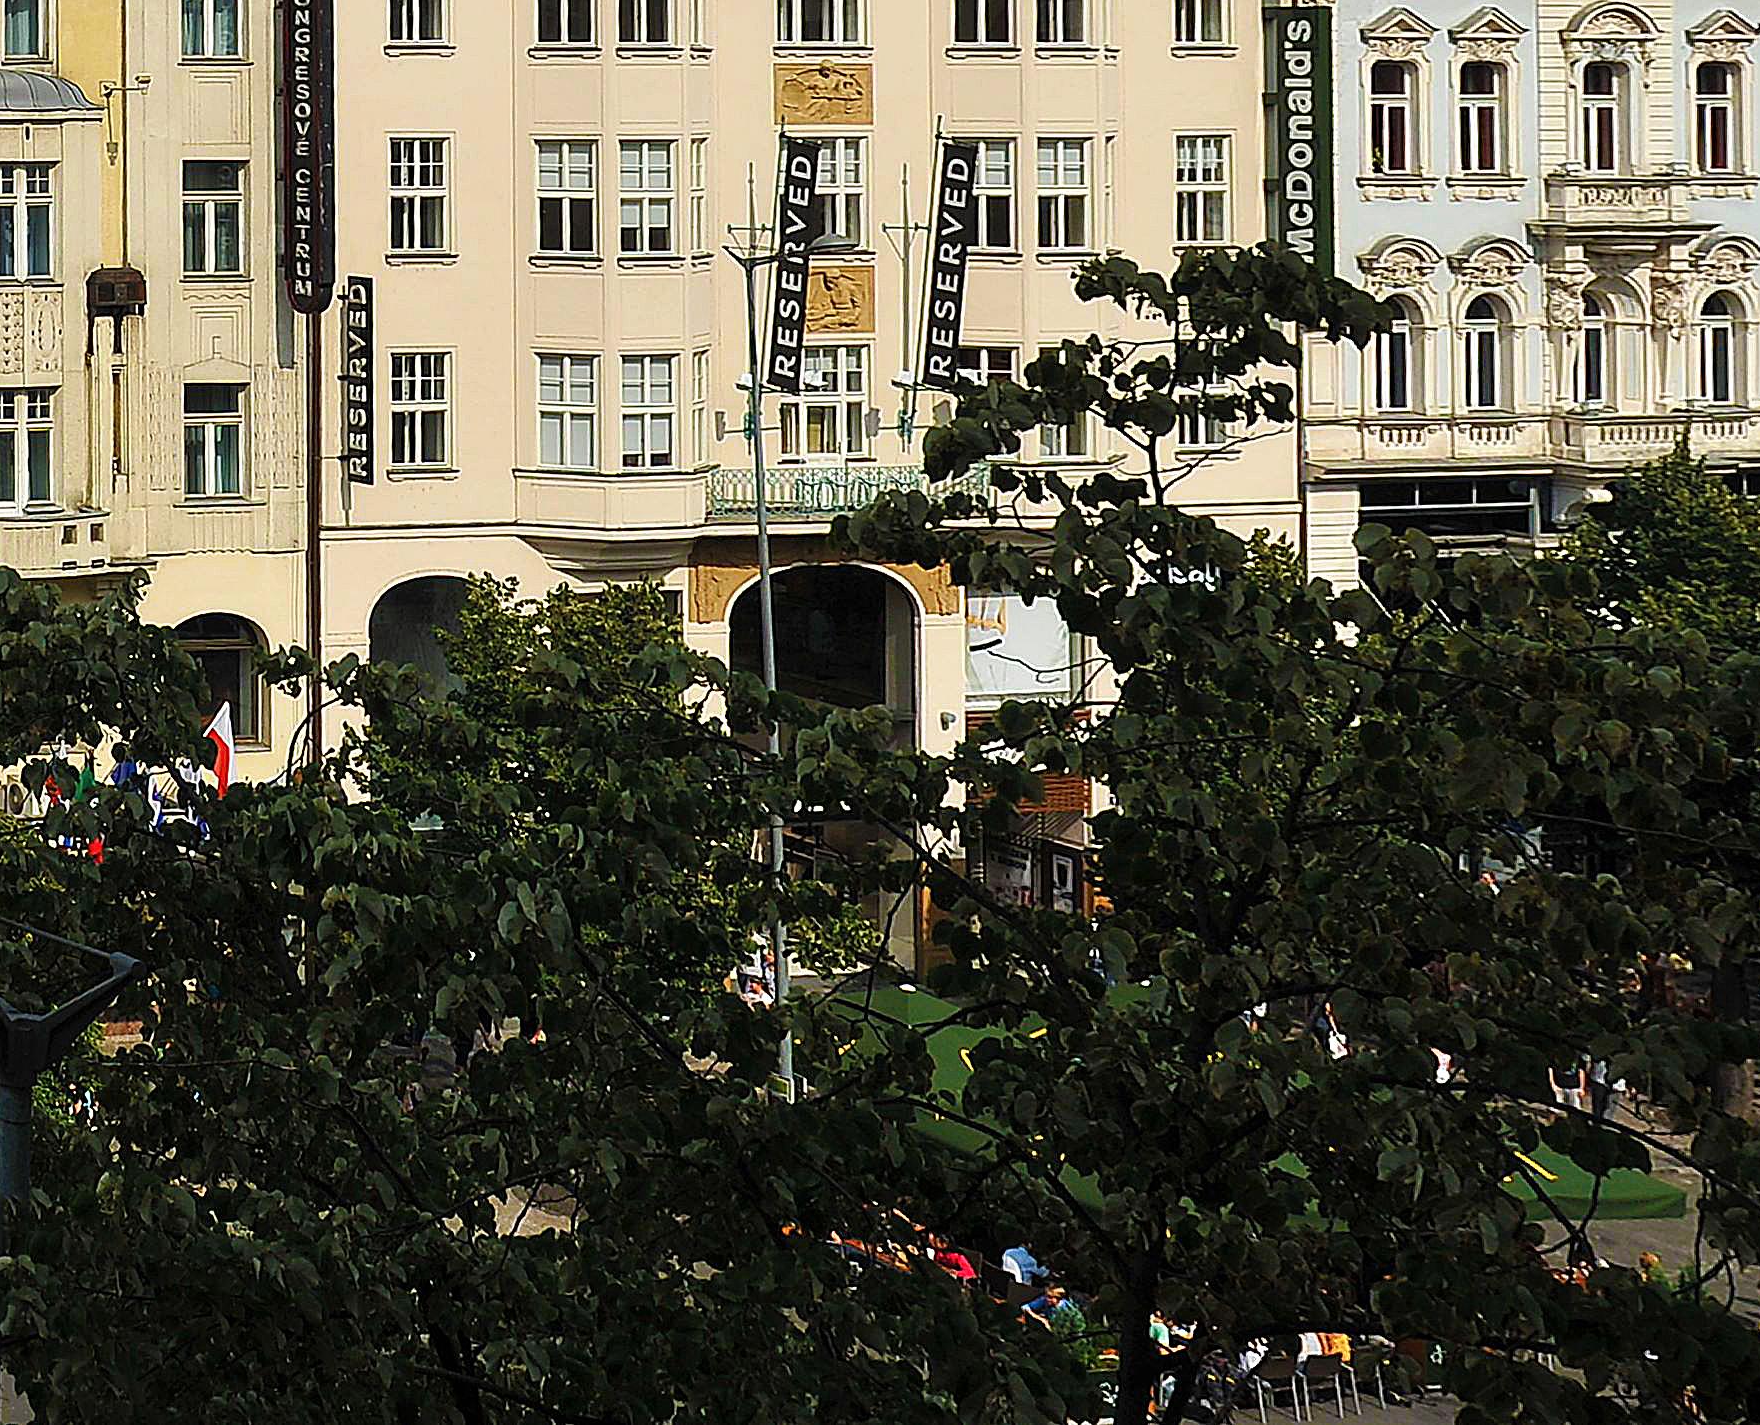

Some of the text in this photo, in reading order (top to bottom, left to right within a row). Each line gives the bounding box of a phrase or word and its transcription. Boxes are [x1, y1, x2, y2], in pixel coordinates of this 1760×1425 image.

[292, 167, 314, 298] CENTRUM
[774, 153, 812, 379] RESERVED
[929, 157, 970, 379] RESERVED
[348, 281, 370, 479] RESERVED
